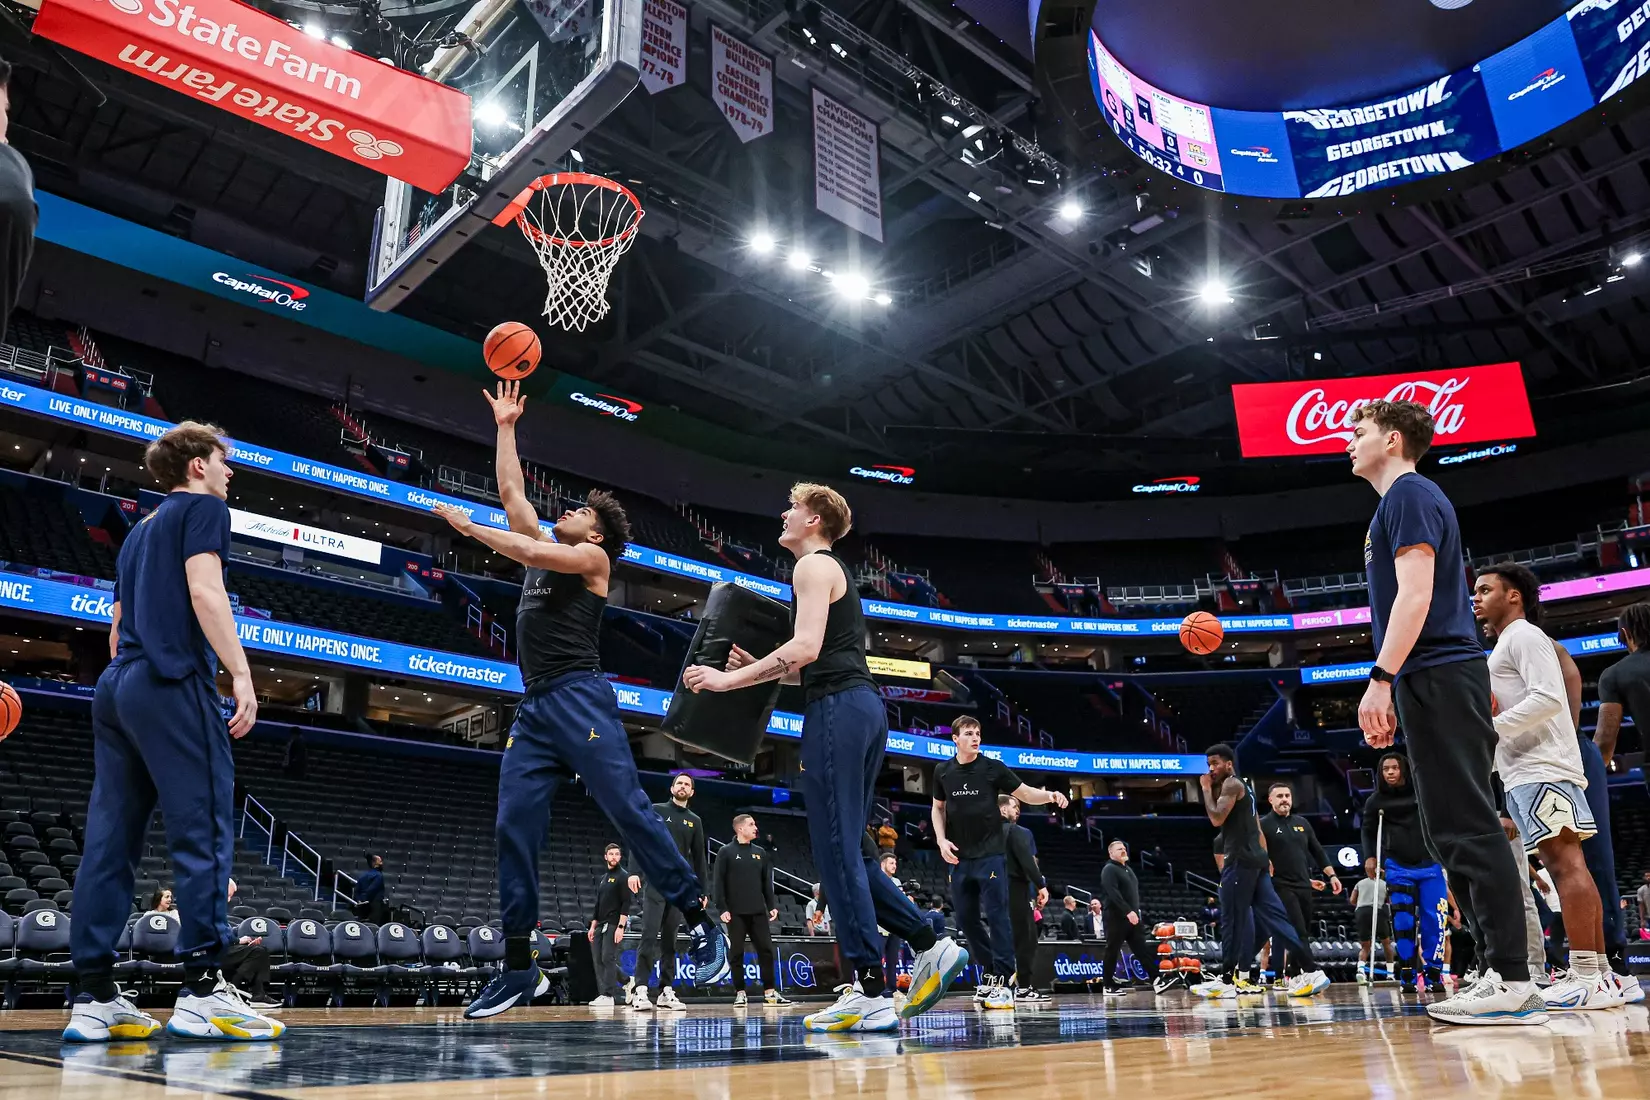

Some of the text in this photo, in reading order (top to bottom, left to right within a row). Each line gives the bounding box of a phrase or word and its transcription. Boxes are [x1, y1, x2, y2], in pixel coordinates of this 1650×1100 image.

[713, 29, 772, 71] WASHINGTON
[725, 48, 761, 77] BULLETS
[716, 71, 769, 109] CONFERENCE
[724, 64, 760, 91] EASTERN
[717, 84, 767, 118] CHAMPIONS
[823, 98, 867, 131] DIVISION
[723, 102, 763, 133] 1978-79
[816, 104, 874, 144] CHAMPIONS
[1325, 120, 1448, 162] GEORGETOWN
[1138, 145, 1173, 176] 50:32
[1304, 150, 1475, 199] GEORGETOWN
[49, 398, 71, 414] LIVE
[73, 404, 99, 421] ONLY
[99, 411, 143, 432] HAPPENS
[292, 460, 391, 496] LIVE ONLY HAPPENS ONCE.
[490, 512, 505, 525] LIVE
[244, 519, 345, 550] Michelob ULTRA
[655, 554, 723, 581] LIVE ONLY HAPPENS ONCE.
[523, 587, 552, 596] CATAPULT
[734, 576, 782, 596] ticketmaster
[868, 603, 918, 619] ticketmaster
[929, 611, 995, 627] LIVE ONLY HAPPENS ONCE.
[1007, 618, 1059, 630] ticketmaster
[1232, 619, 1246, 628] ONLY
[1246, 618, 1273, 628] HAPPENS
[1273, 617, 1290, 627] ONCE.
[1301, 611, 1343, 626] PERIOD 1
[1070, 621, 1139, 632] LIVE ONLY HAPPENS ONCE.
[236, 622, 383, 663] LIVE ONLY HAPPENS ONCE.
[1581, 639, 1601, 650] LIVE
[408, 654, 507, 684] ticketmaster
[618, 689, 643, 707] ONCE.
[771, 715, 790, 730] ONLY
[927, 741, 940, 754] LIVE
[1018, 752, 1079, 769] ticketmaster
[1092, 758, 1183, 770] LIVE ONLY HAPPENS ONCE.
[952, 789, 980, 797] CATAPULT
